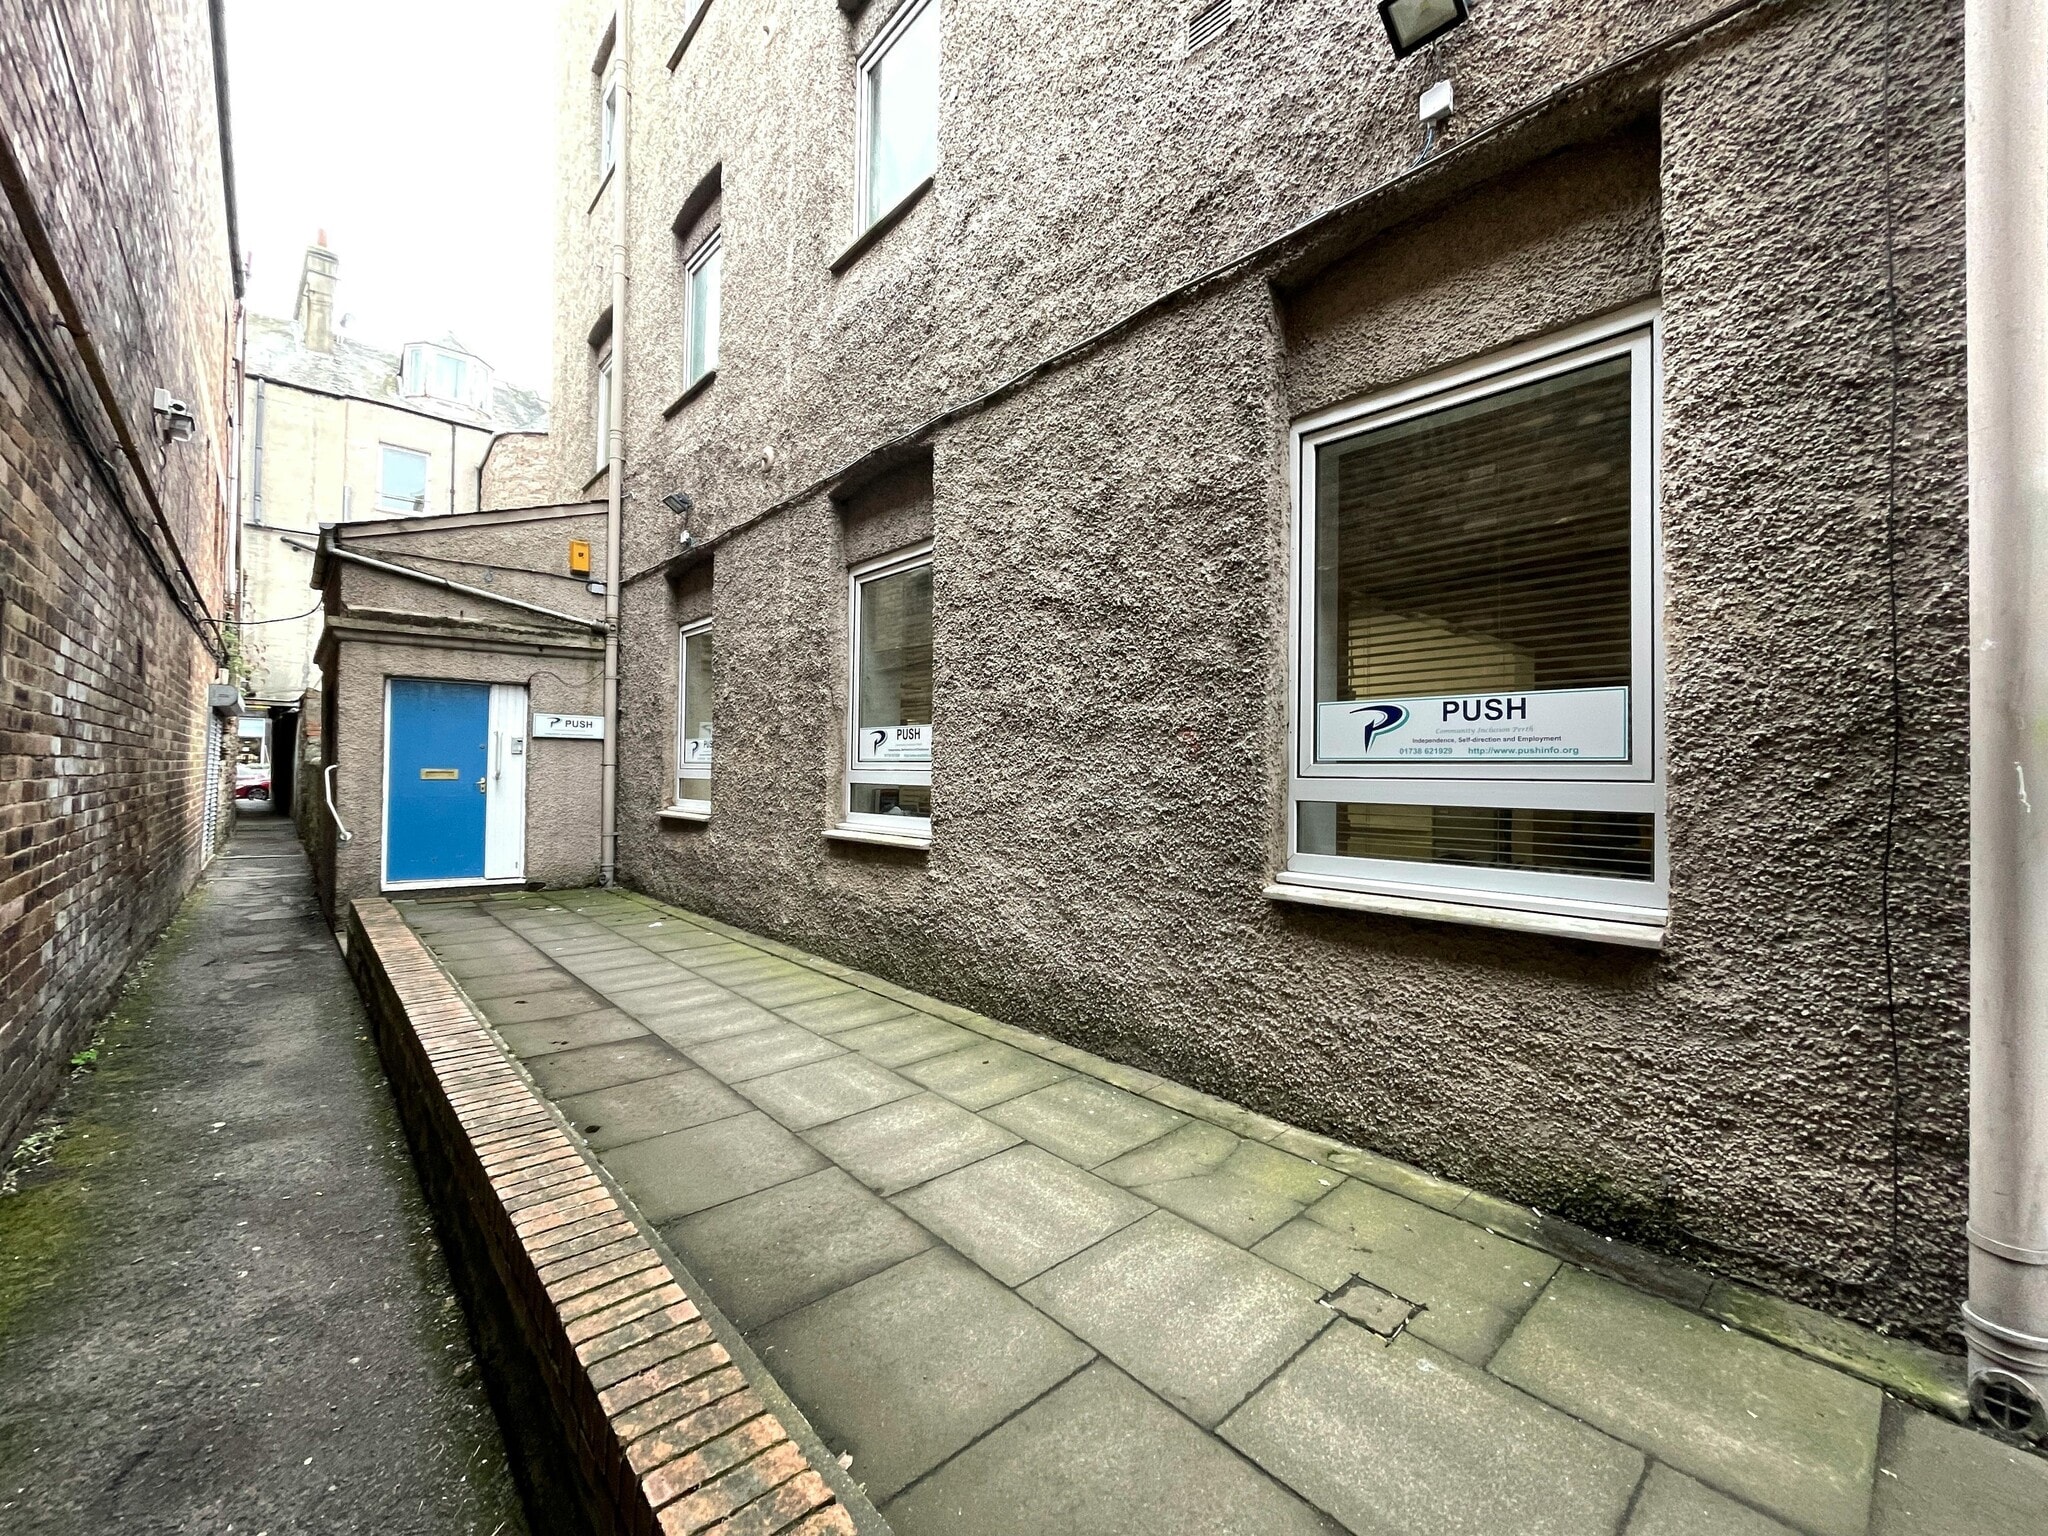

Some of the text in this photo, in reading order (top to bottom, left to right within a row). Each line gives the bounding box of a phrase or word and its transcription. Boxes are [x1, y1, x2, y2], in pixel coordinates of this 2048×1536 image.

[1443, 697, 1526, 722] PUSH
[565, 720, 593, 728] PUSH
[897, 728, 920, 740] PUSH
[1468, 746, 1579, 755] http://www.pushinfo.org
